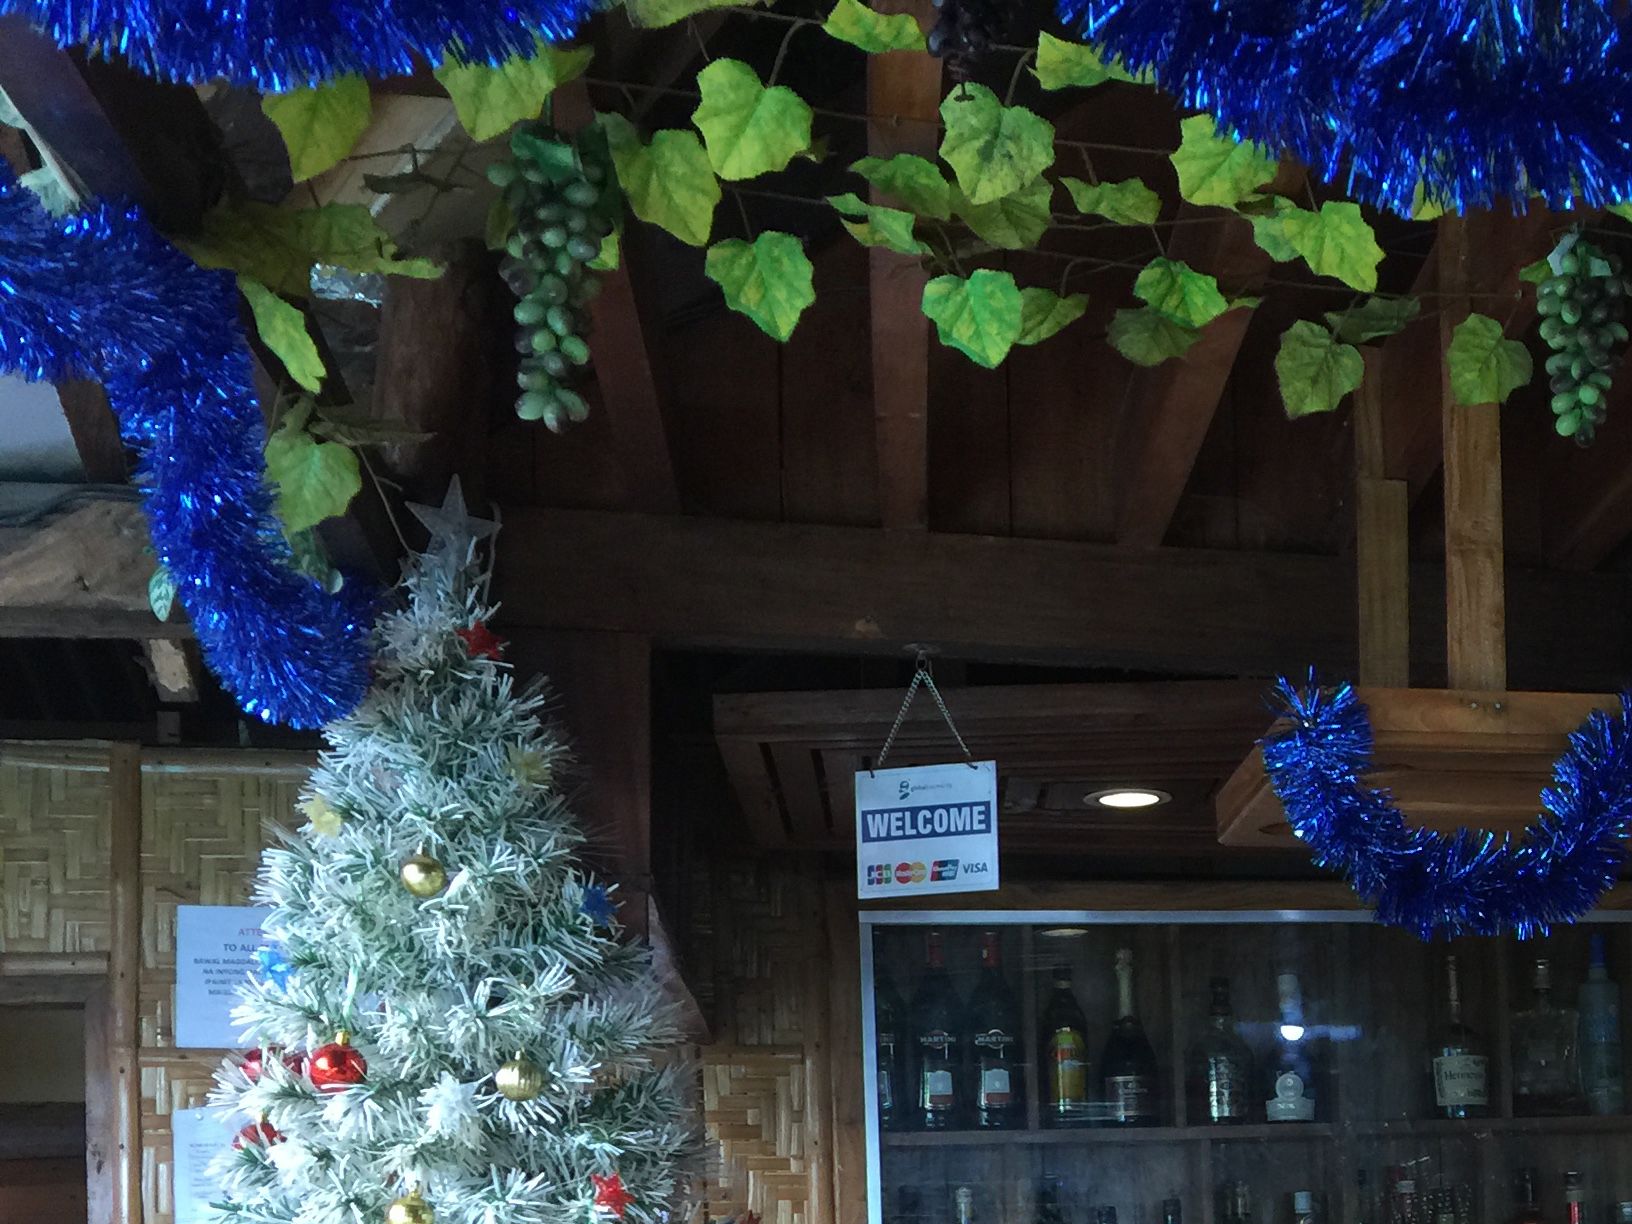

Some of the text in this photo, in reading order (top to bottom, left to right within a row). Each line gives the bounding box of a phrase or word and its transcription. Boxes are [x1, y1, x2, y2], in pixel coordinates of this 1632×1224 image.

[866, 805, 987, 839] WELCOME
[962, 862, 989, 875] VISA
[224, 943, 257, 952] TO ALL
